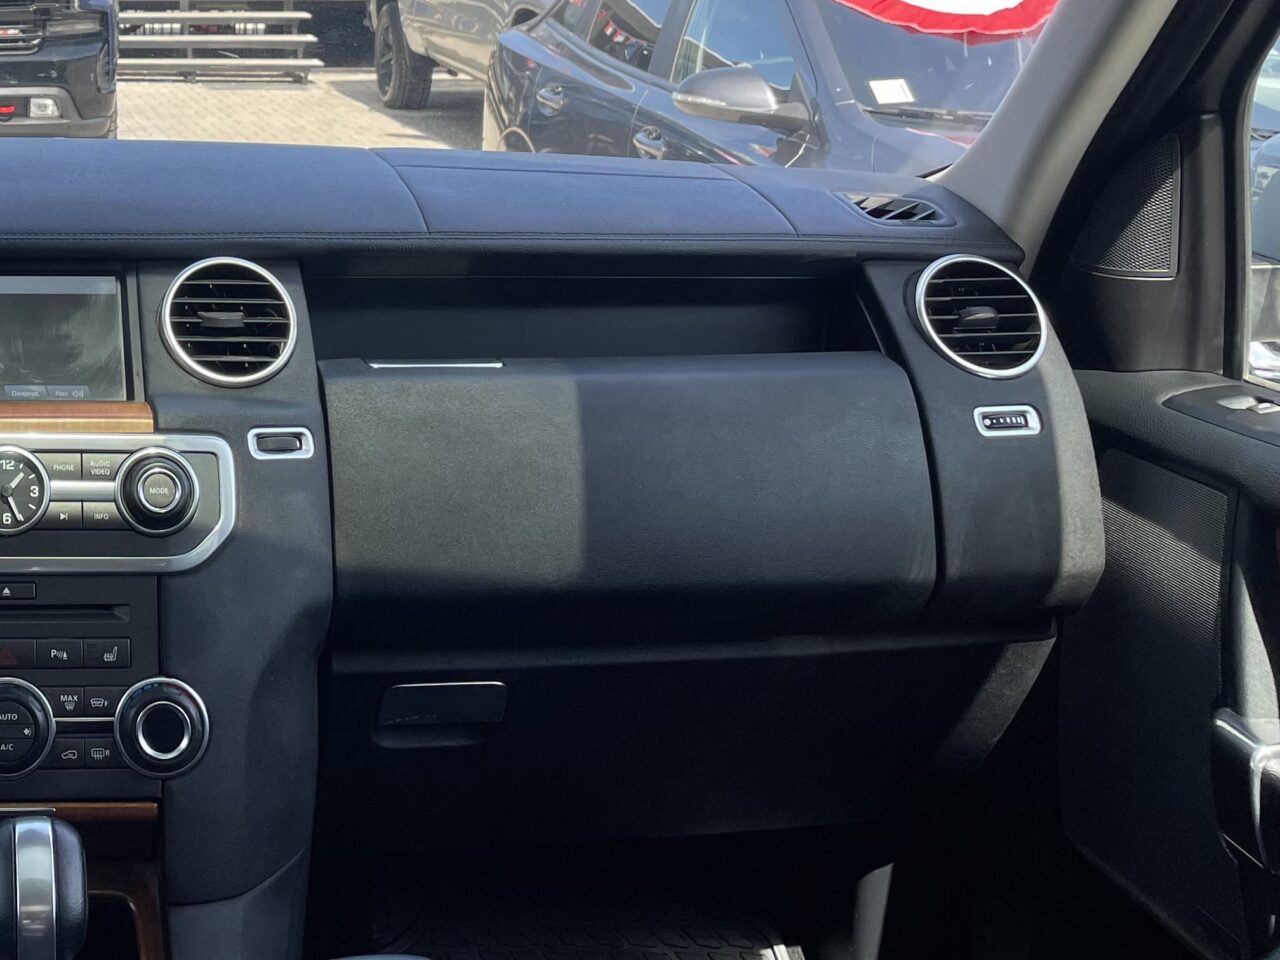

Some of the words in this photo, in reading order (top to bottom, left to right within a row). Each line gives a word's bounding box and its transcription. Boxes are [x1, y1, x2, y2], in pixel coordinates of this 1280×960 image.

[0, 459, 15, 470] 12
[29, 486, 39, 497] 3
[149, 487, 169, 495] MODE
[2, 513, 12, 525] 6
[59, 694, 78, 702] MAX
[0, 743, 14, 751] A/C
